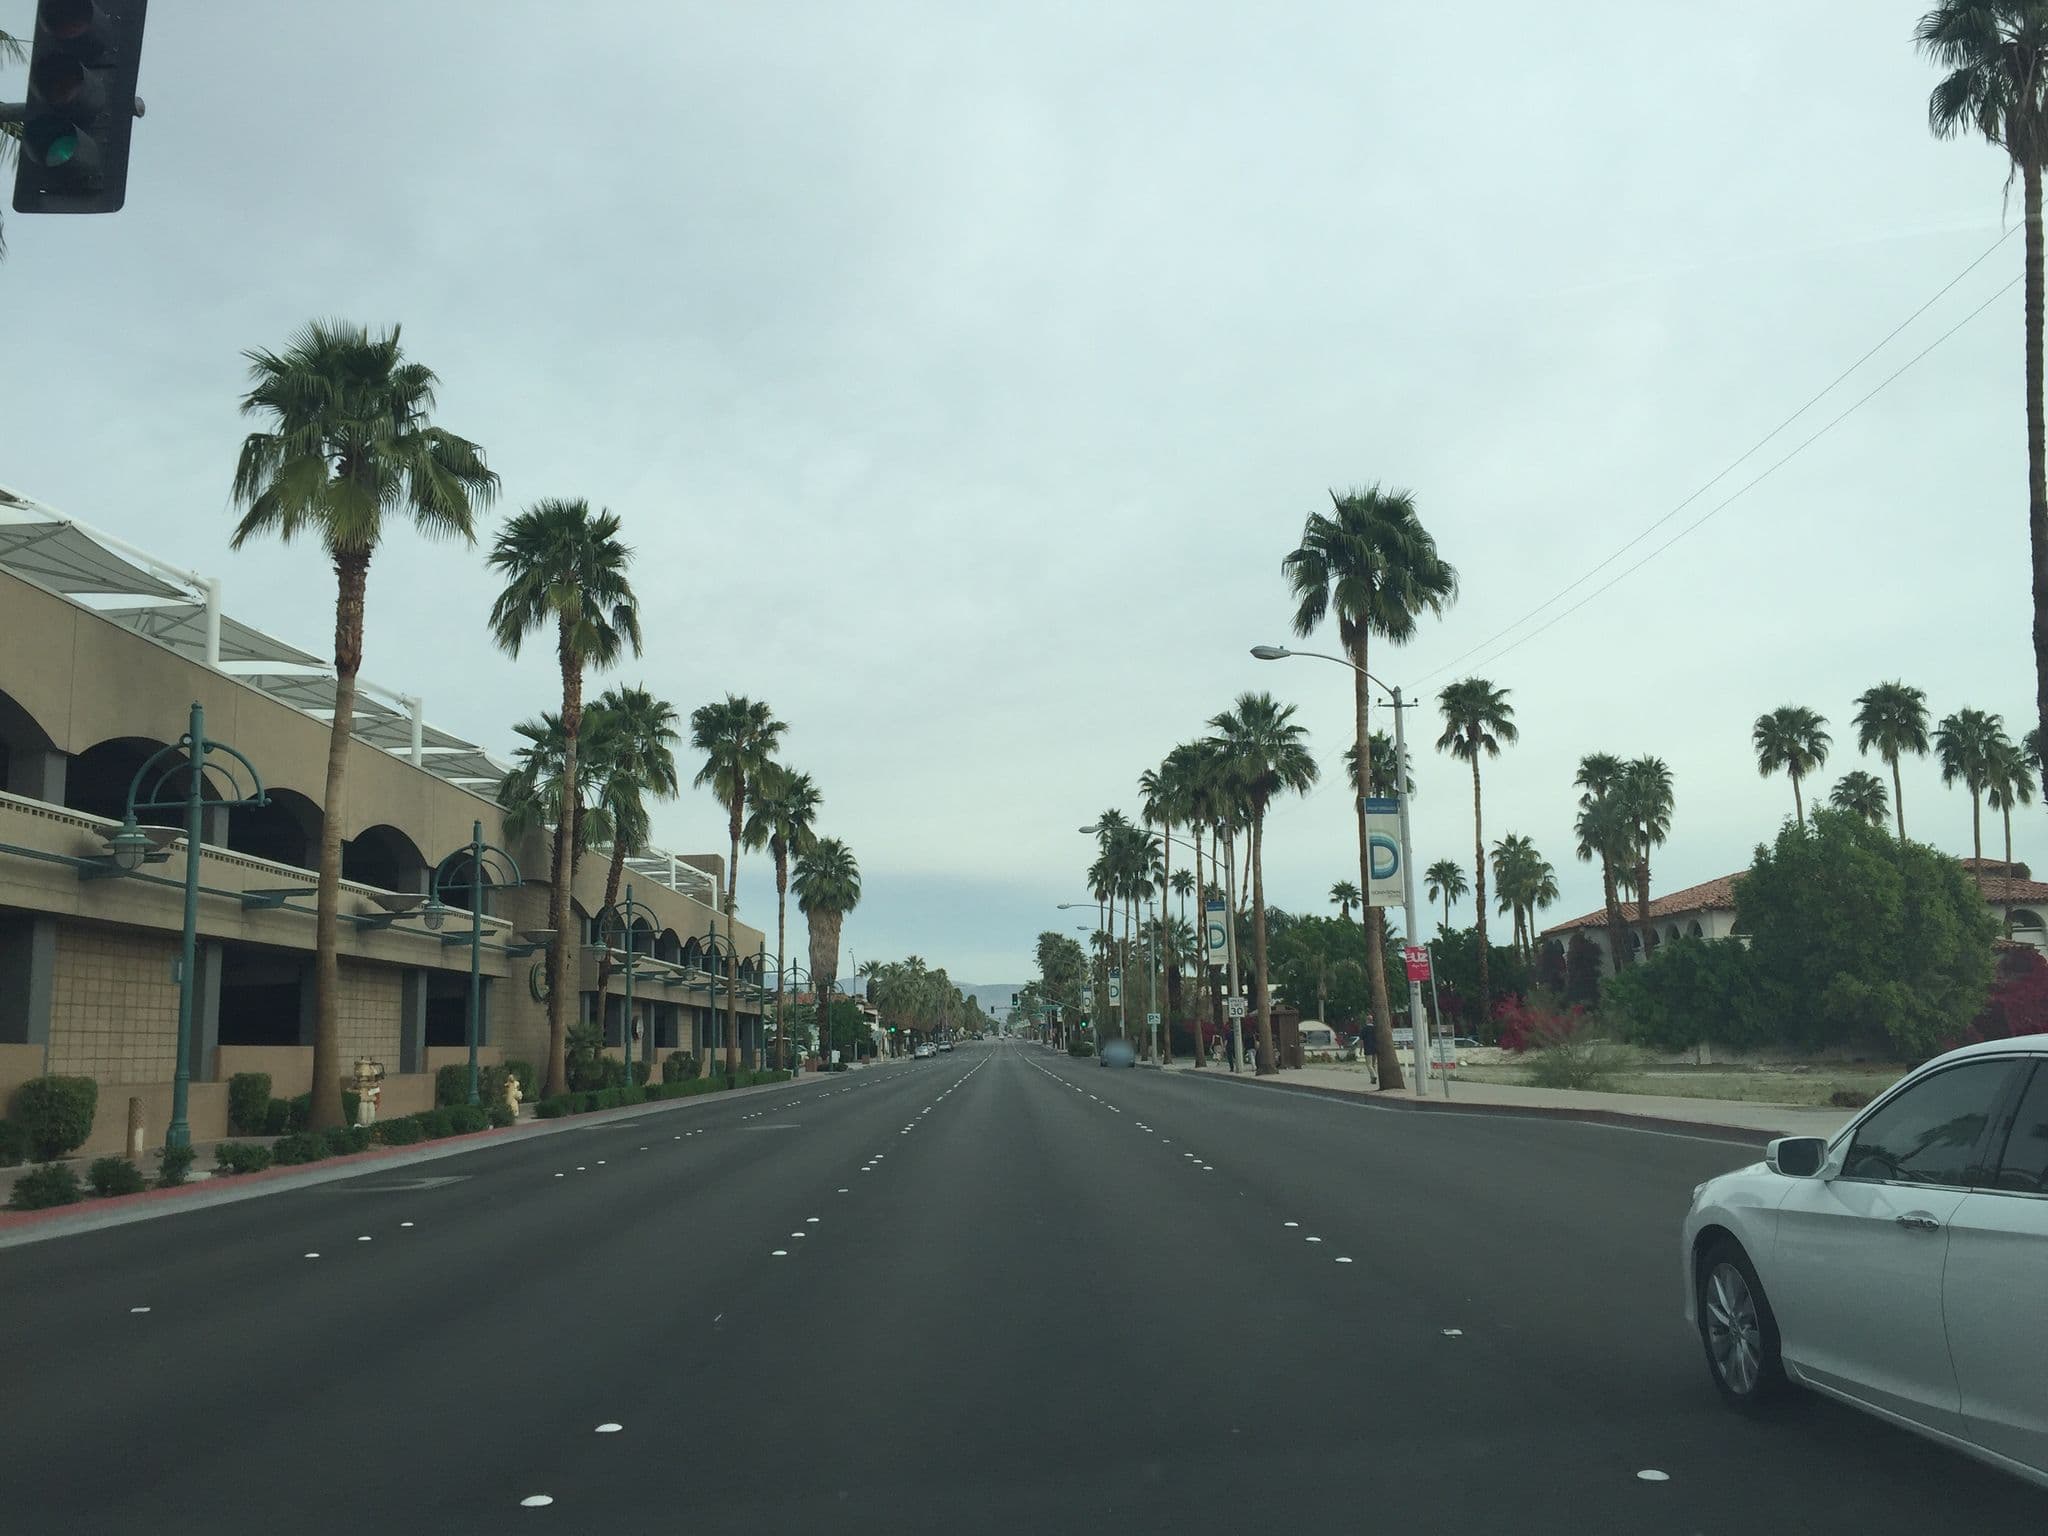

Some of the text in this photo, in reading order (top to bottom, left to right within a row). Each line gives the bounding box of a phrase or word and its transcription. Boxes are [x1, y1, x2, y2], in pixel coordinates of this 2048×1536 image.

[1369, 833, 1399, 880] D
[1209, 922, 1226, 950] D
[1230, 1007, 1243, 1015] 30
